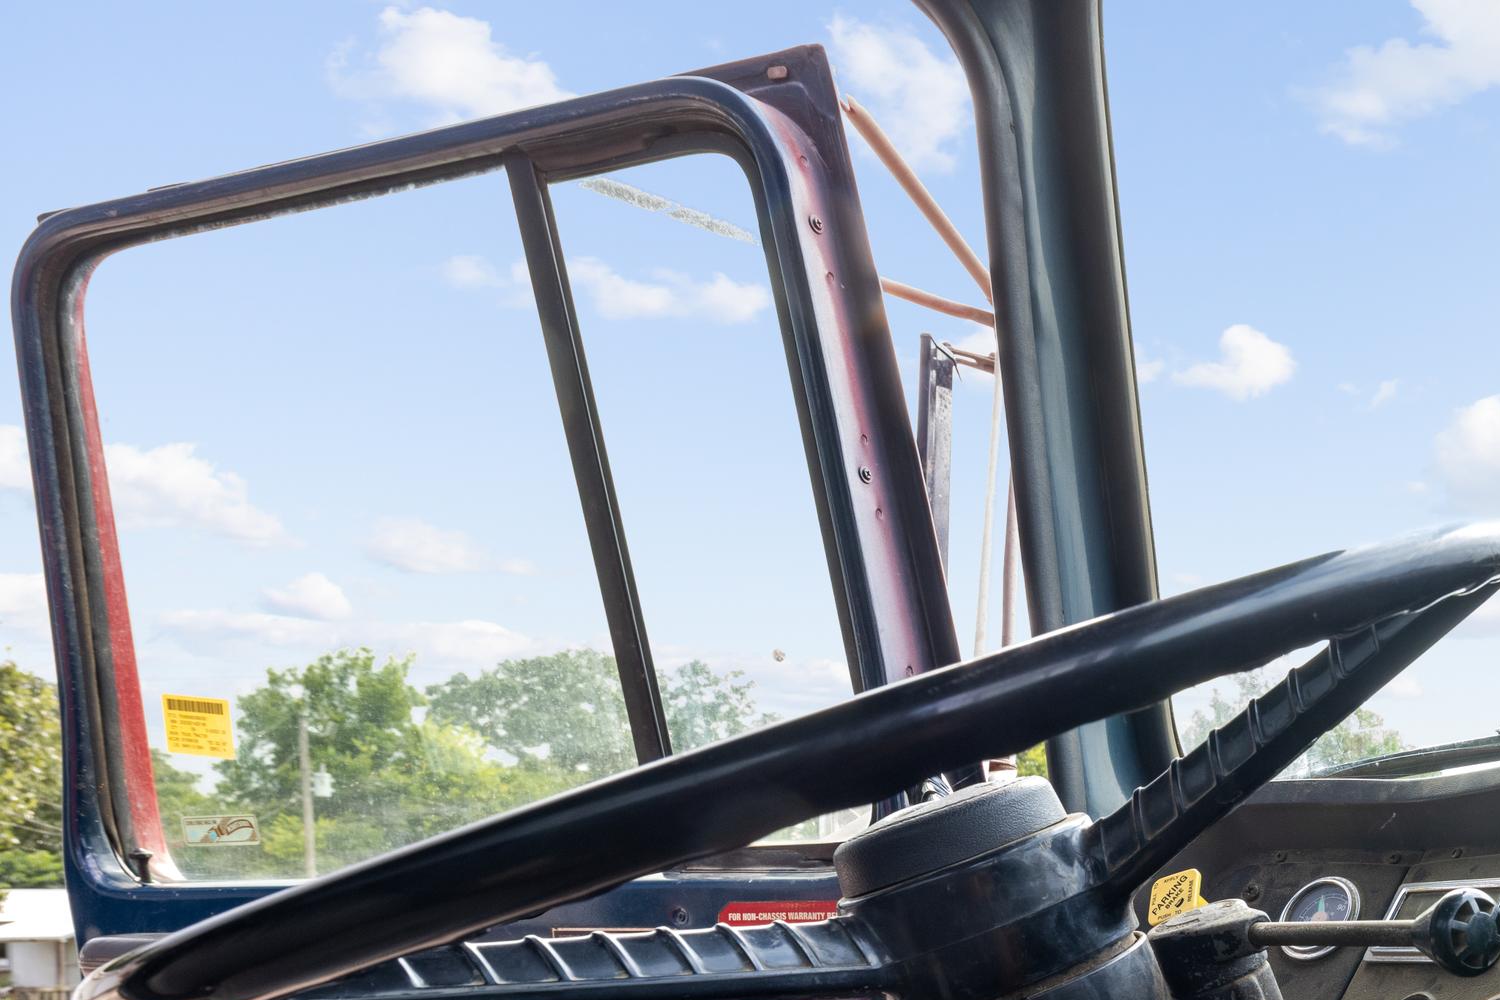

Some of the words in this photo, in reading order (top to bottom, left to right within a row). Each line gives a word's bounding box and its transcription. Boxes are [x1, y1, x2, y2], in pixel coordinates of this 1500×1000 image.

[1151, 875, 1188, 916] PARKING
[1165, 888, 1184, 909] BRAKE
[728, 912, 741, 921] FOR
[742, 912, 787, 921] NON-CHASSIS
[787, 911, 826, 920] WARRANTY
